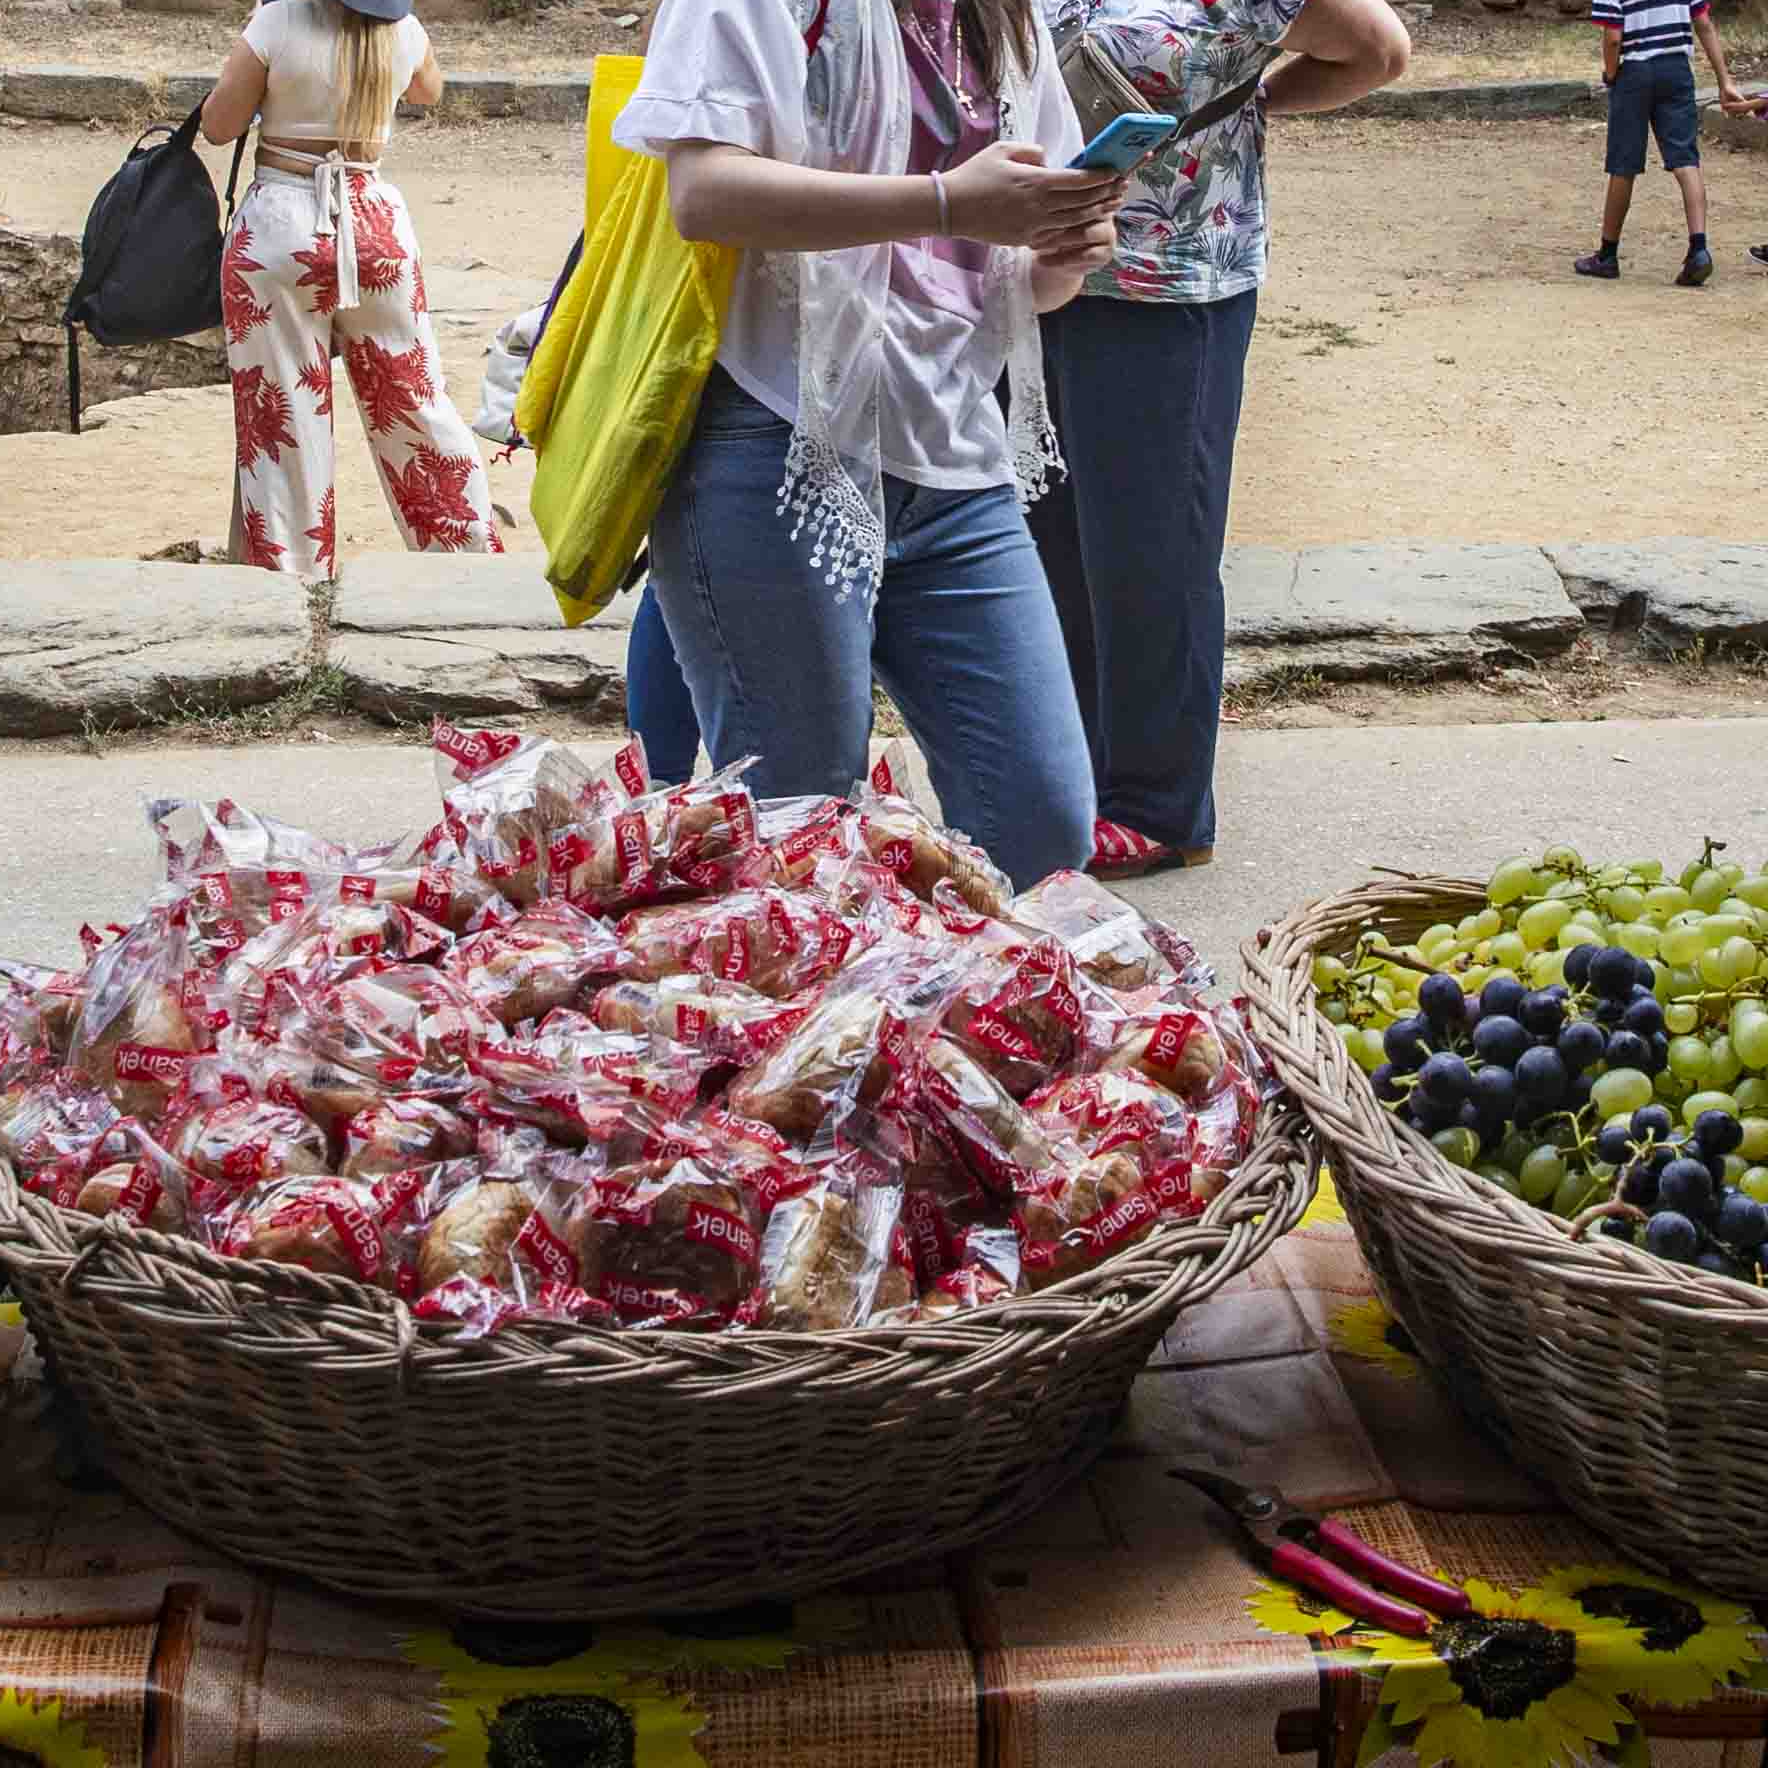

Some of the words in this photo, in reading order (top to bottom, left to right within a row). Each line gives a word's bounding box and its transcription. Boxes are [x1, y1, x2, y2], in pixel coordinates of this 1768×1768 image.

[1150, 1015, 1184, 1060] nek
[118, 1050, 183, 1075] sanek
[694, 1210, 755, 1253] anek
[910, 1202, 943, 1272] sane
[1089, 1194, 1148, 1246] sanek
